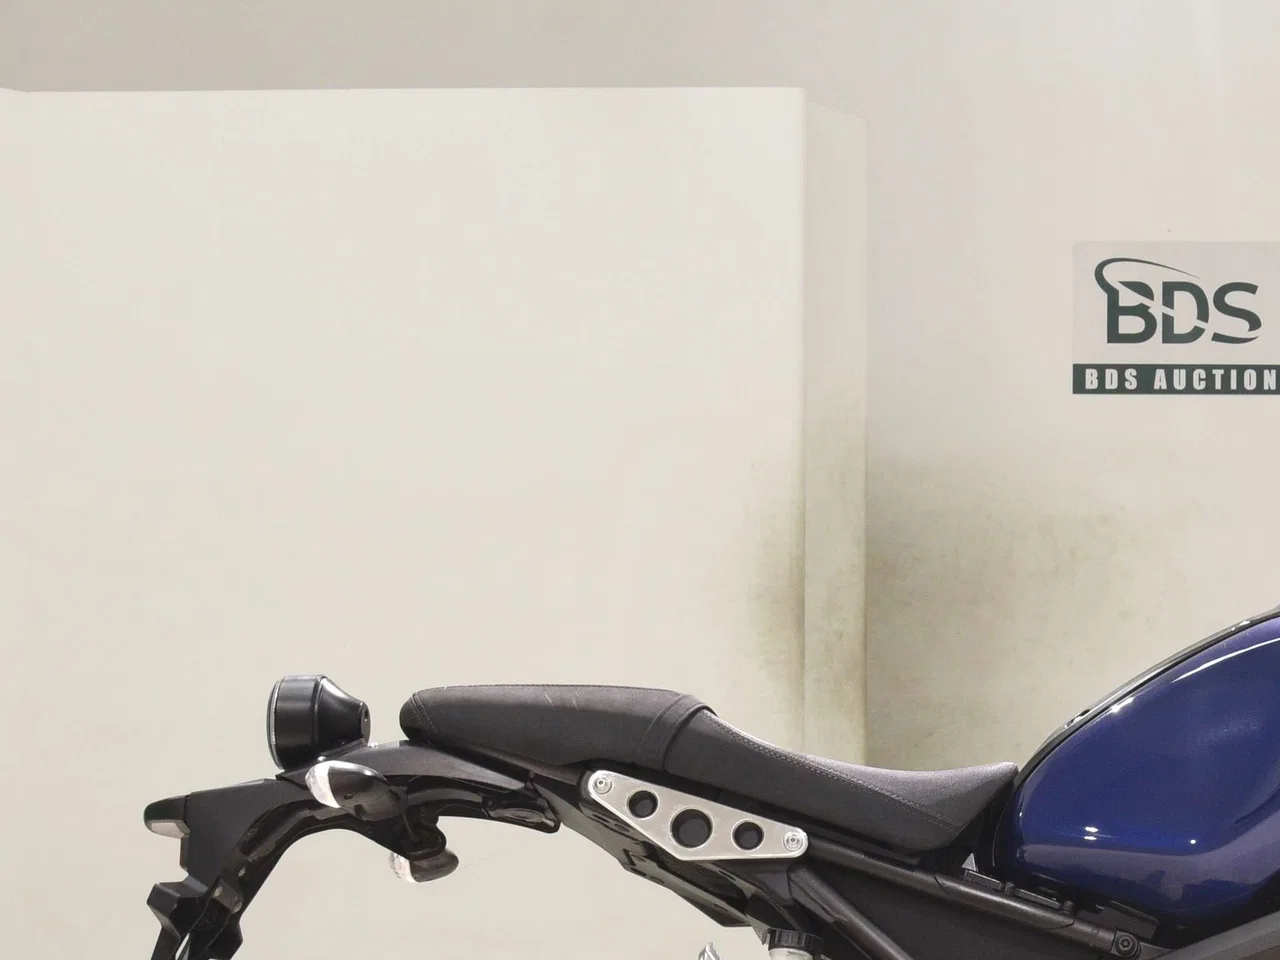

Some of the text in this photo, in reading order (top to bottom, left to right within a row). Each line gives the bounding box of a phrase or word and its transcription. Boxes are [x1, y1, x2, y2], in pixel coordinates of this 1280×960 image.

[1094, 258, 1263, 344] BDS
[1084, 368, 1277, 390] BDS AUCTION
